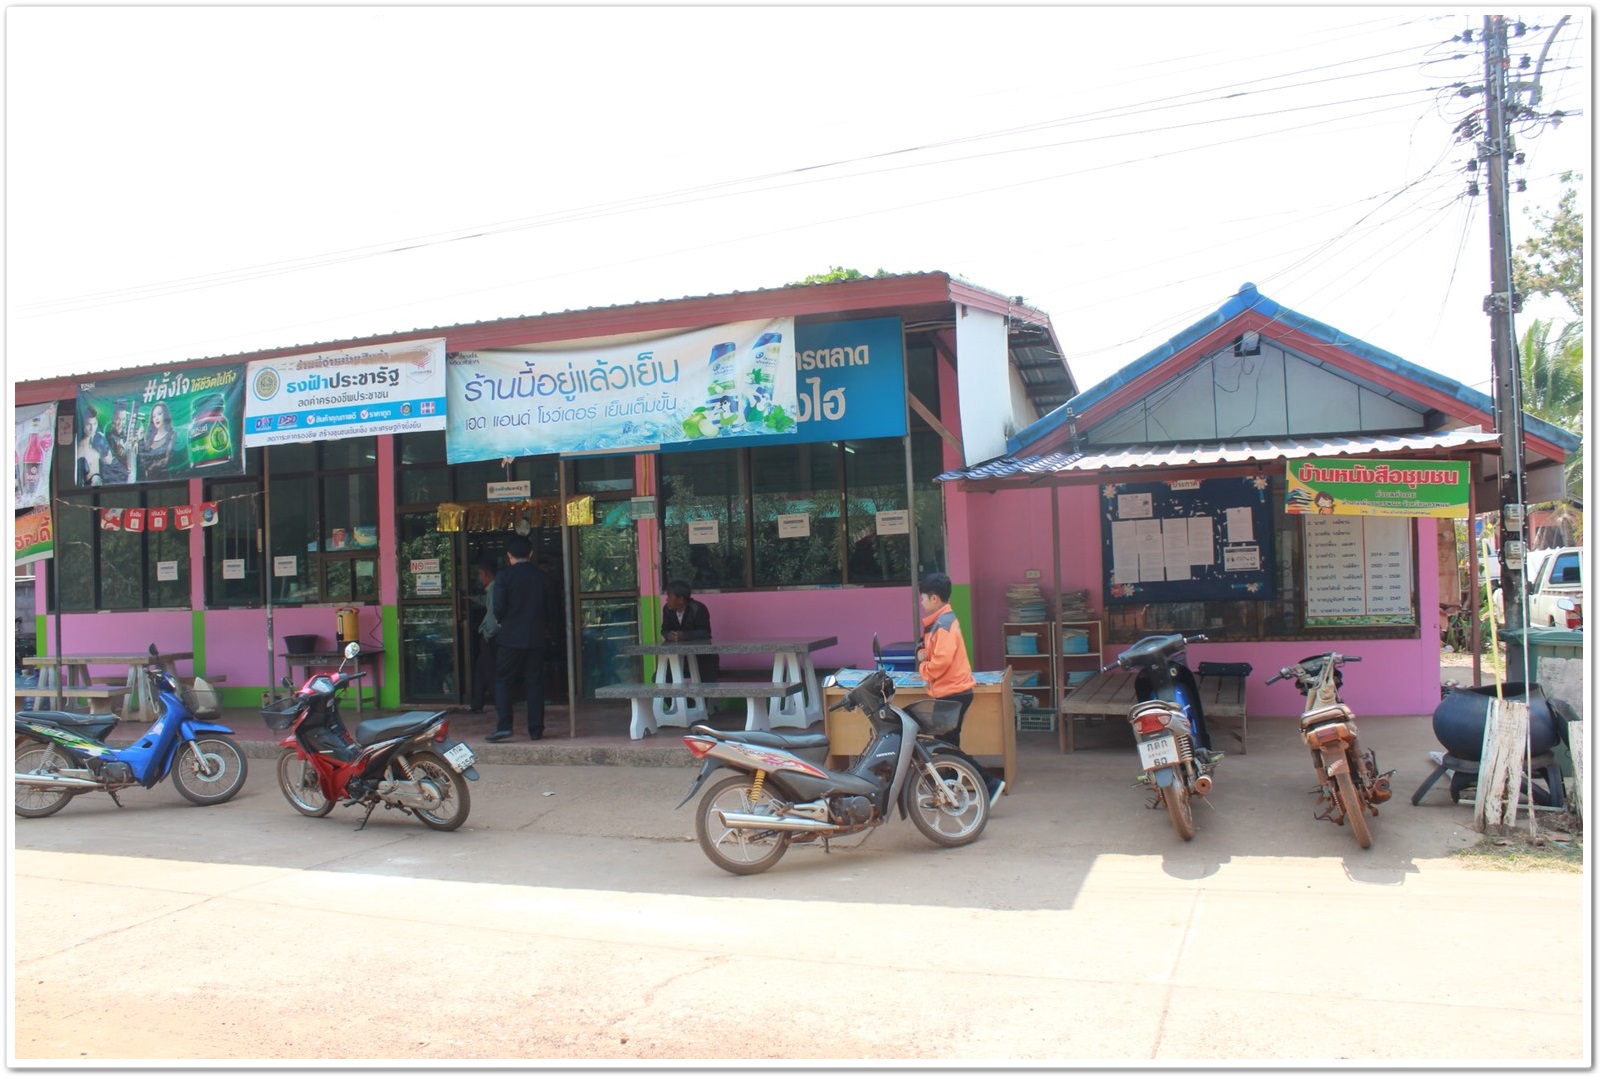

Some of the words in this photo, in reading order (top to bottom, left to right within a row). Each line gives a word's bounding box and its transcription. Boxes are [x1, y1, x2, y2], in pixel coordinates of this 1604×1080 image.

[143, 371, 189, 403] #ตั้งใจ
[286, 366, 400, 394] ธงฟ้าประชารัฐ
[464, 351, 679, 402] ร้านนี้อยู่แล้วเย็น
[298, 389, 389, 407] ลดค่าครองชีพประชาชน
[465, 415, 486, 431] เฮด
[493, 409, 531, 427] แอนด์
[538, 403, 598, 424] โชว์เดอร์
[604, 391, 677, 418] เย็นเต็มขั้น
[1299, 463, 1459, 489] บ้านหนังสือชุมชน
